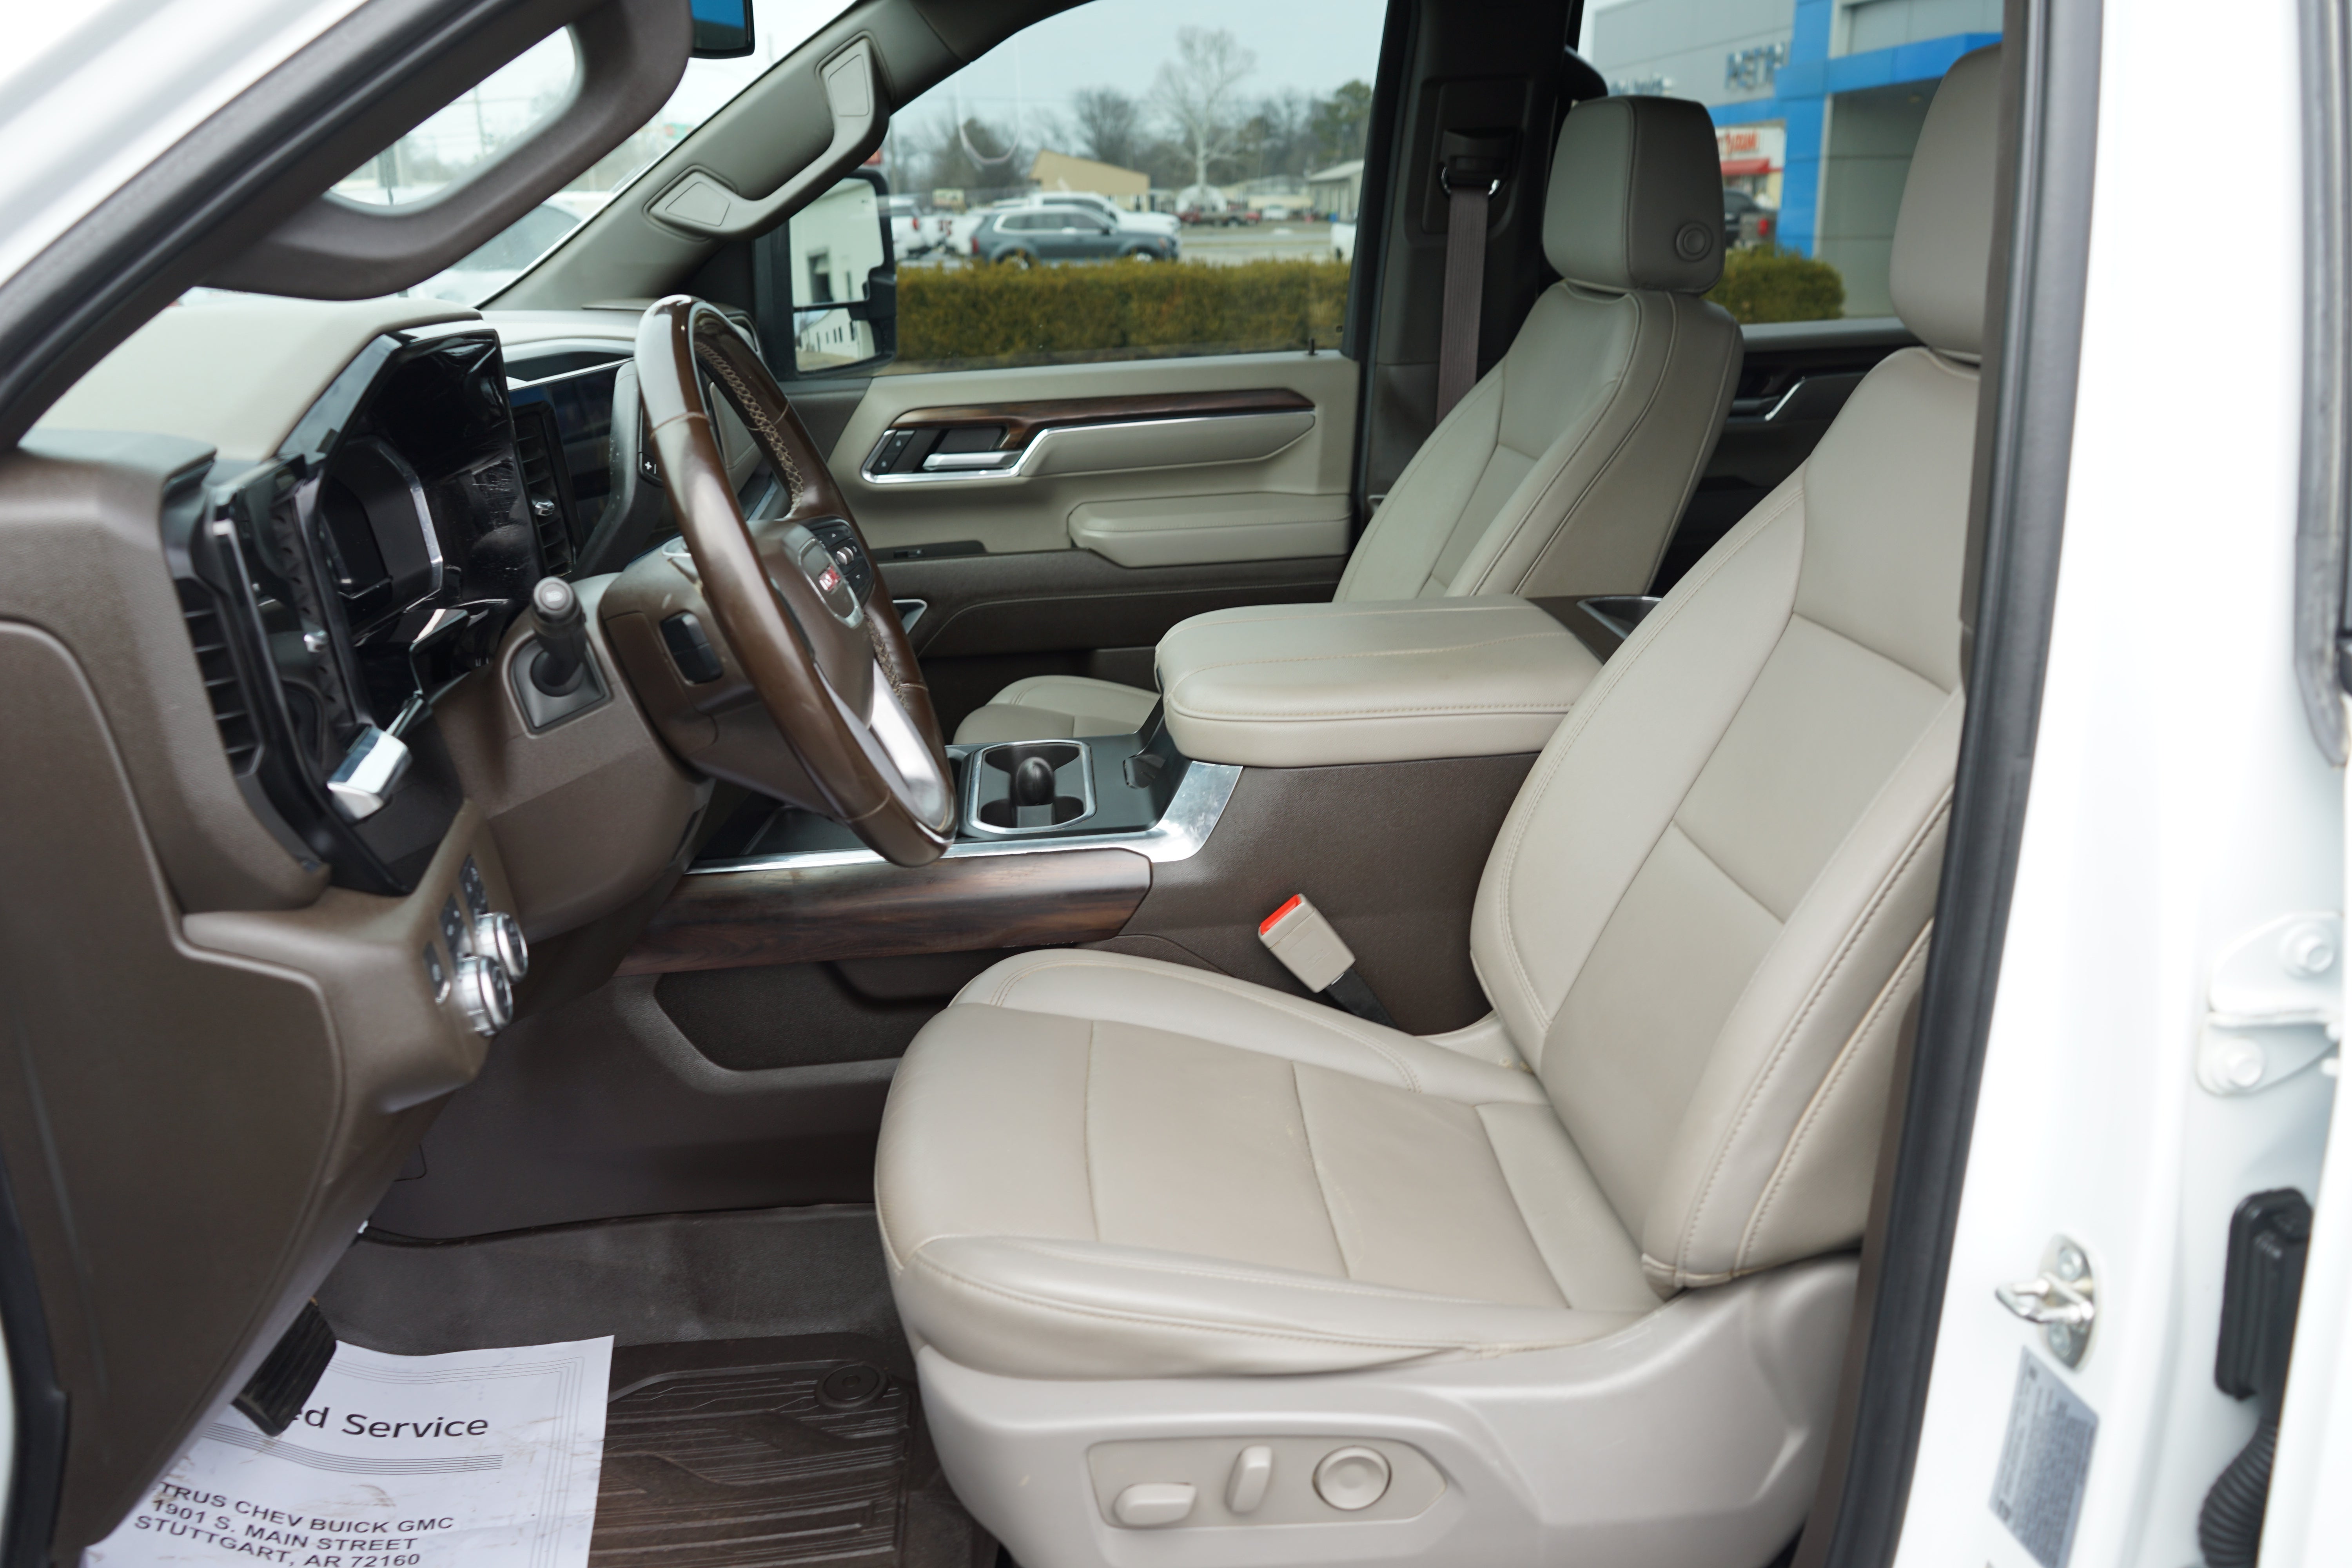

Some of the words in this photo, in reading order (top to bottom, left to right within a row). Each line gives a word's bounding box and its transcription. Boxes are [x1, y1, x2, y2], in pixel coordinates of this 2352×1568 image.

[341, 1413, 489, 1438] Service
[152, 1499, 205, 1523] 1901
[214, 1516, 235, 1532] S.
[245, 1524, 309, 1548] MAIN
[316, 1537, 418, 1551] STREET
[235, 1501, 303, 1527] CHEV
[309, 1518, 390, 1533] BUICK
[397, 1517, 455, 1532] GMC
[134, 1515, 295, 1567] STUTTGART,
[303, 1555, 341, 1568] AR
[351, 1553, 421, 1568] 72160
